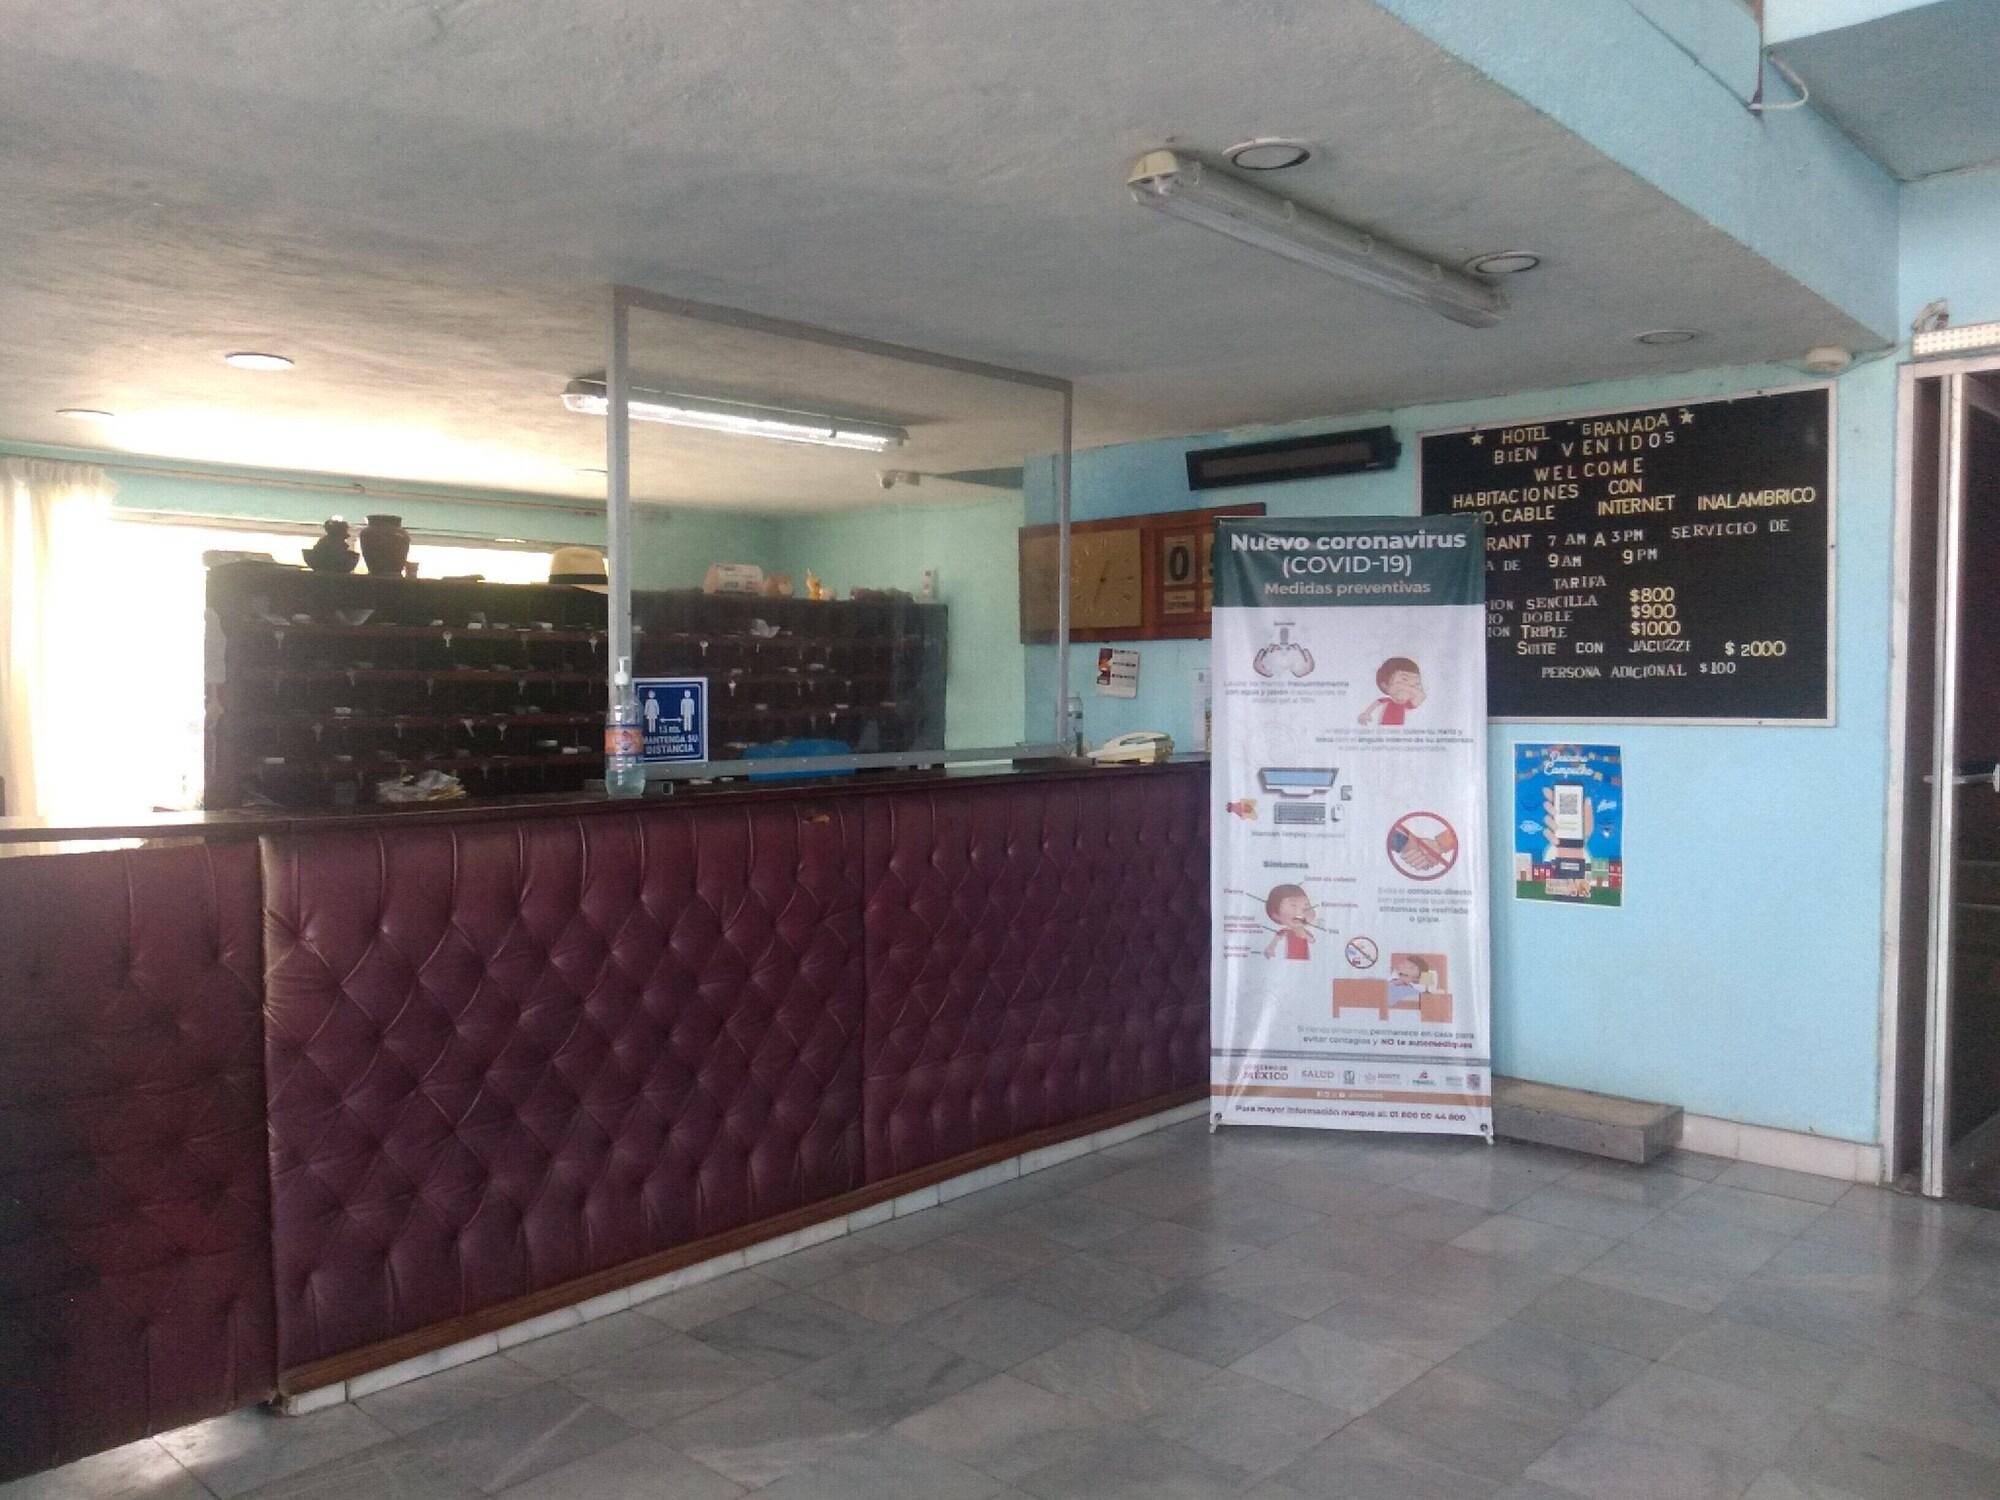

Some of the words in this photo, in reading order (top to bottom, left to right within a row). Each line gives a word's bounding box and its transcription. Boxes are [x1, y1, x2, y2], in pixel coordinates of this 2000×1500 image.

[1502, 426, 1550, 445] HOTEL
[1582, 412, 1670, 437] GRANADA
[1494, 447, 1538, 464] BIEN
[1534, 457, 1644, 482] WELCOME
[1453, 484, 1580, 509] HABITACIONES
[1608, 478, 1643, 495] CON
[1502, 505, 1556, 524] CABLE
[1598, 494, 1676, 517] INTERNET
[1697, 486, 1817, 512] INALAMBRICO
[1231, 533, 1310, 551] Nuevo
[1316, 529, 1467, 550] coronavirus
[1593, 531, 1607, 547] A
[1671, 521, 1758, 540] SERVICIO
[1769, 519, 1791, 533] DE
[1282, 554, 1412, 578] (COVID-19)
[1503, 560, 1521, 571] DE
[1264, 582, 1333, 595] Medidas
[1337, 580, 1432, 597] preventivas
[1553, 575, 1608, 590] TARIFA
[1526, 594, 1599, 611] SENCILLA
[1629, 586, 1676, 603] $800
[1521, 610, 1574, 624] DOBLE
[1630, 602, 1676, 619] $900
[1630, 619, 1682, 636] $1000
[1575, 641, 1604, 654] CON
[1541, 665, 1601, 679] PERSONA
[1610, 663, 1687, 679] ADICIONAL
